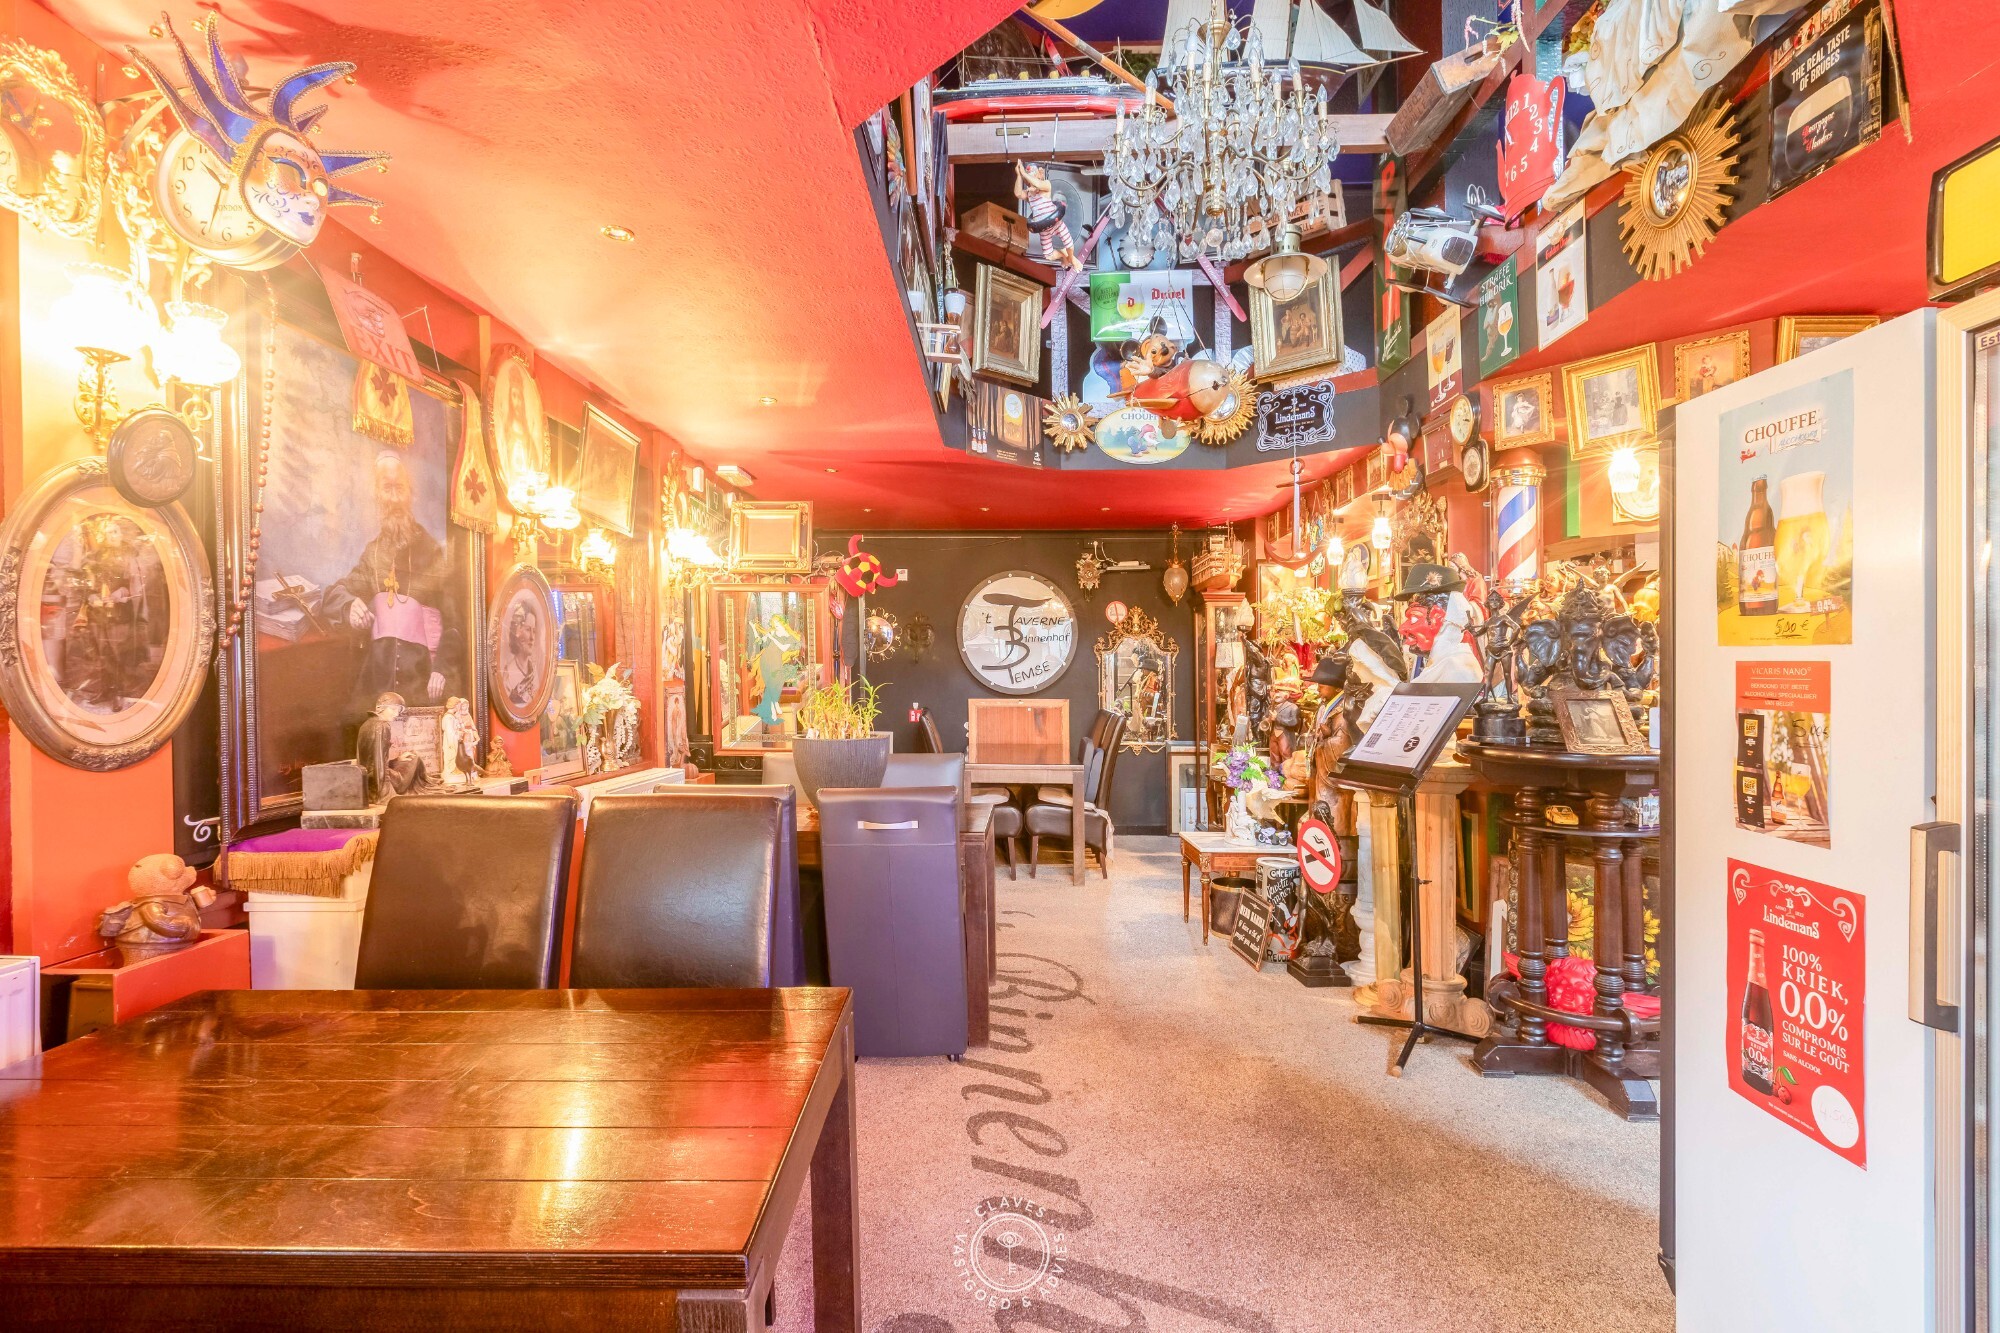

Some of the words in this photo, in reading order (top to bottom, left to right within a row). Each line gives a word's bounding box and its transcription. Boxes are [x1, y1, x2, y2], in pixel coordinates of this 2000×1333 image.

[1791, 60, 1806, 85] THE
[1807, 50, 1825, 72] REAL
[1827, 24, 1851, 55] TASTE
[1800, 76, 1808, 92] OF
[1811, 49, 1841, 85] BRUGES
[349, 324, 414, 376] EXIT
[1121, 413, 1157, 421] CHOUF
[1744, 410, 1818, 444] CHOUFFE
[1742, 551, 1775, 562] CHOUFF
[1751, 667, 1780, 675] VICARIS
[1782, 944, 1822, 972] 100%
[1782, 961, 1849, 1005] KRIEK,
[1780, 981, 1849, 1041] 0,0%
[1782, 1020, 1847, 1059] COMPROMIS
[1782, 1033, 1800, 1048] SUR
[1803, 1043, 1817, 1058] LE
[1819, 1050, 1850, 1074] GOÛT
[1783, 1050, 1797, 1063] SANS
[1798, 1058, 1823, 1075] ALCOOL
